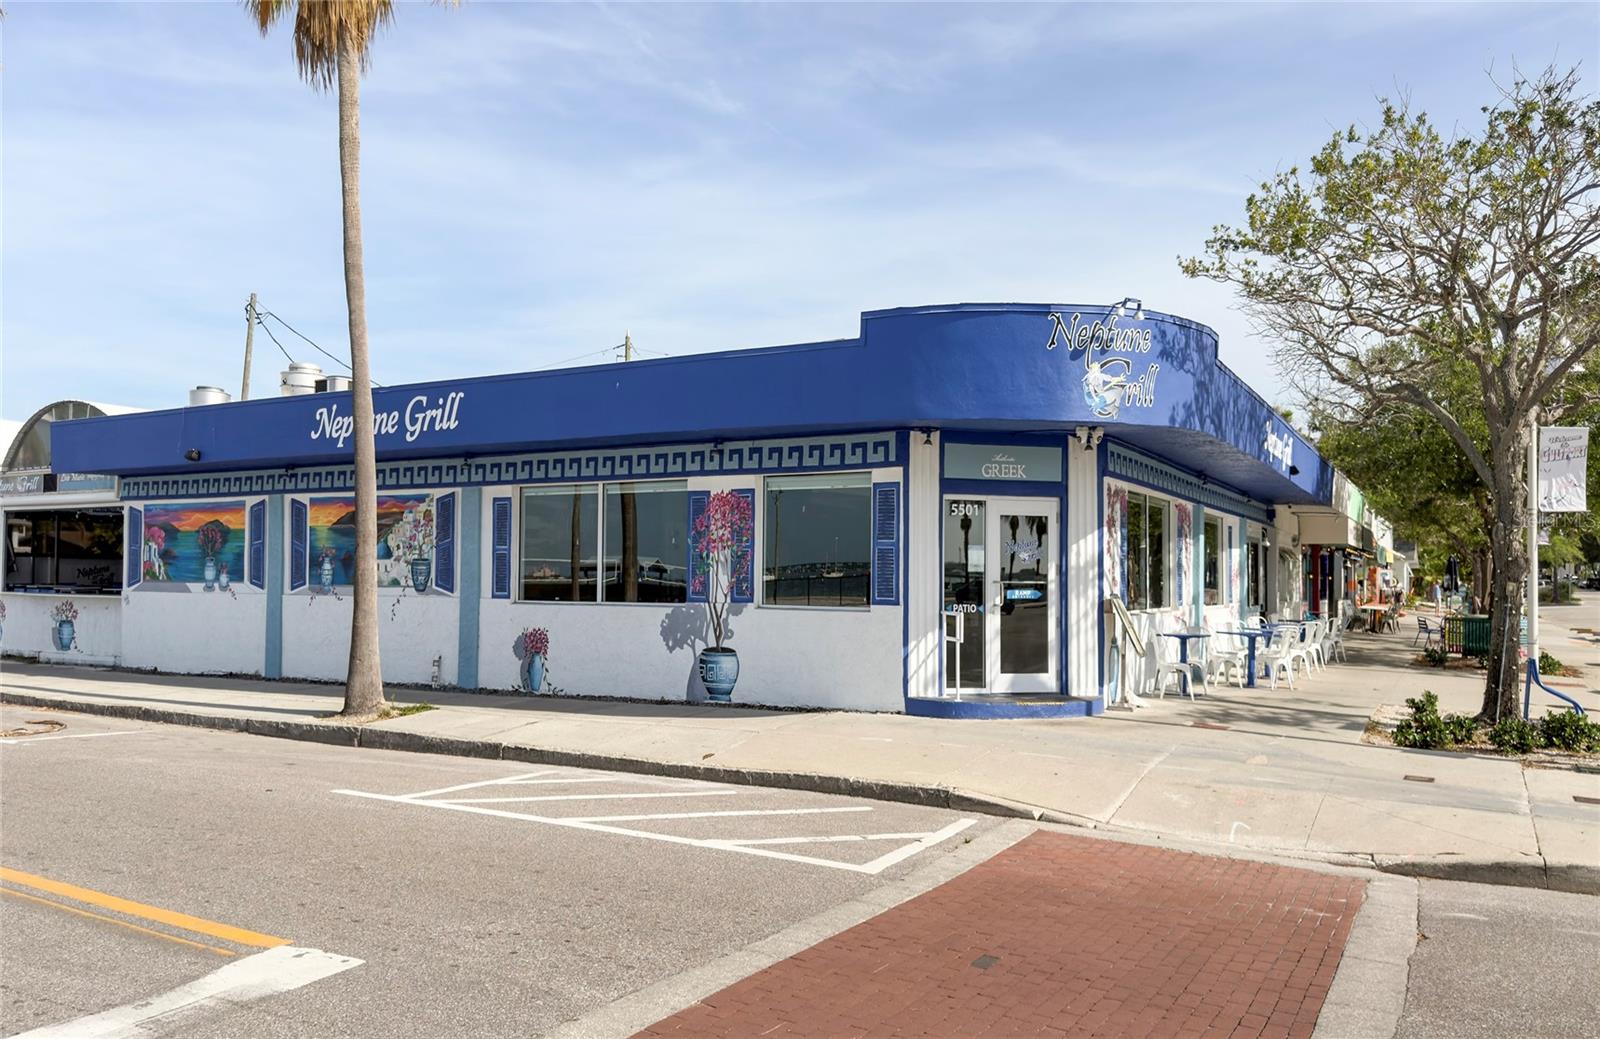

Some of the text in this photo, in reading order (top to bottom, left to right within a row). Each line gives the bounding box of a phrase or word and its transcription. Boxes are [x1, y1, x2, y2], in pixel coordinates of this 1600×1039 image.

[1047, 312, 1151, 371] Neptune
[1083, 357, 1159, 418] Grill
[311, 392, 464, 448] Nepne Grill
[981, 463, 1027, 479] GREEK
[951, 503, 979, 516] 5501
[952, 604, 977, 613] PATIO
